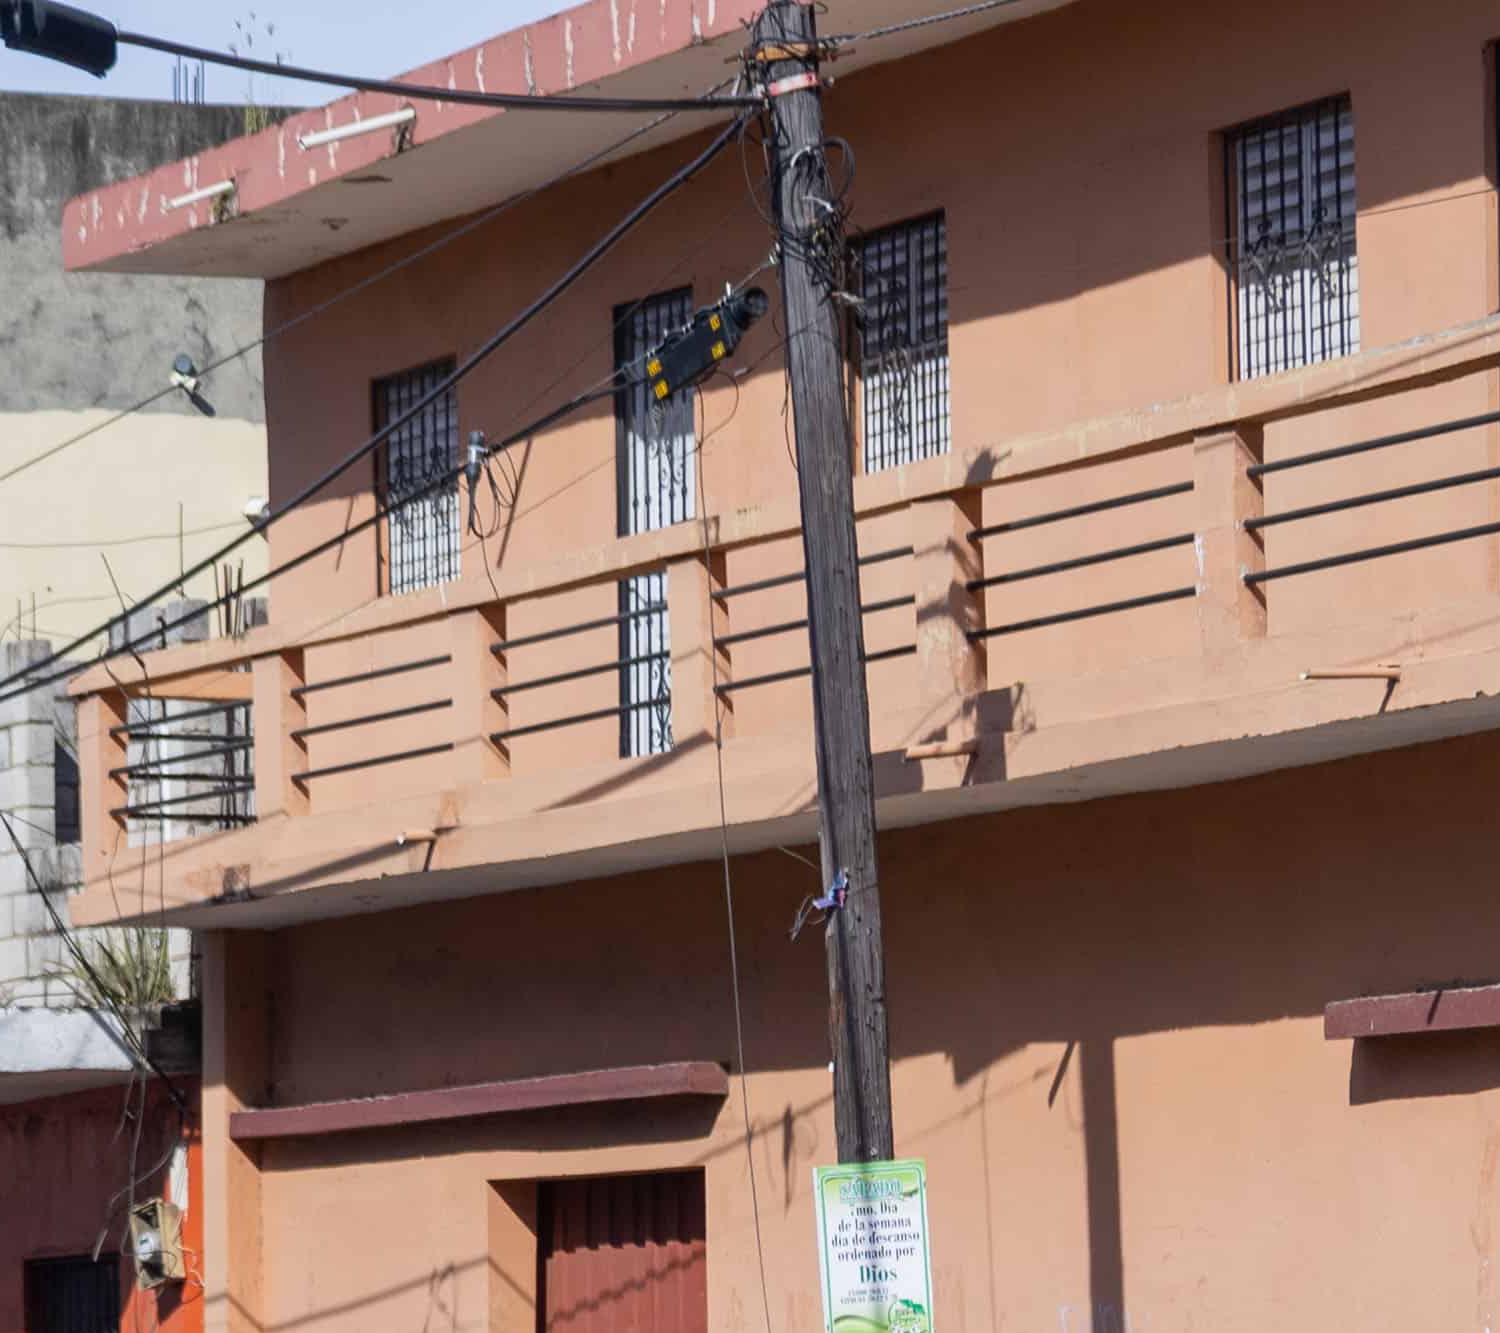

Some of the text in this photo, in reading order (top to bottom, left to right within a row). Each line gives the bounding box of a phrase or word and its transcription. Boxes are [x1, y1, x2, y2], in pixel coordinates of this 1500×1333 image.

[838, 1216, 912, 1233] de la semana
[852, 1232, 866, 1246] de
[868, 1231, 920, 1246] descanso
[838, 1246, 916, 1262] ordenado por
[860, 1264, 898, 1284] Dios
